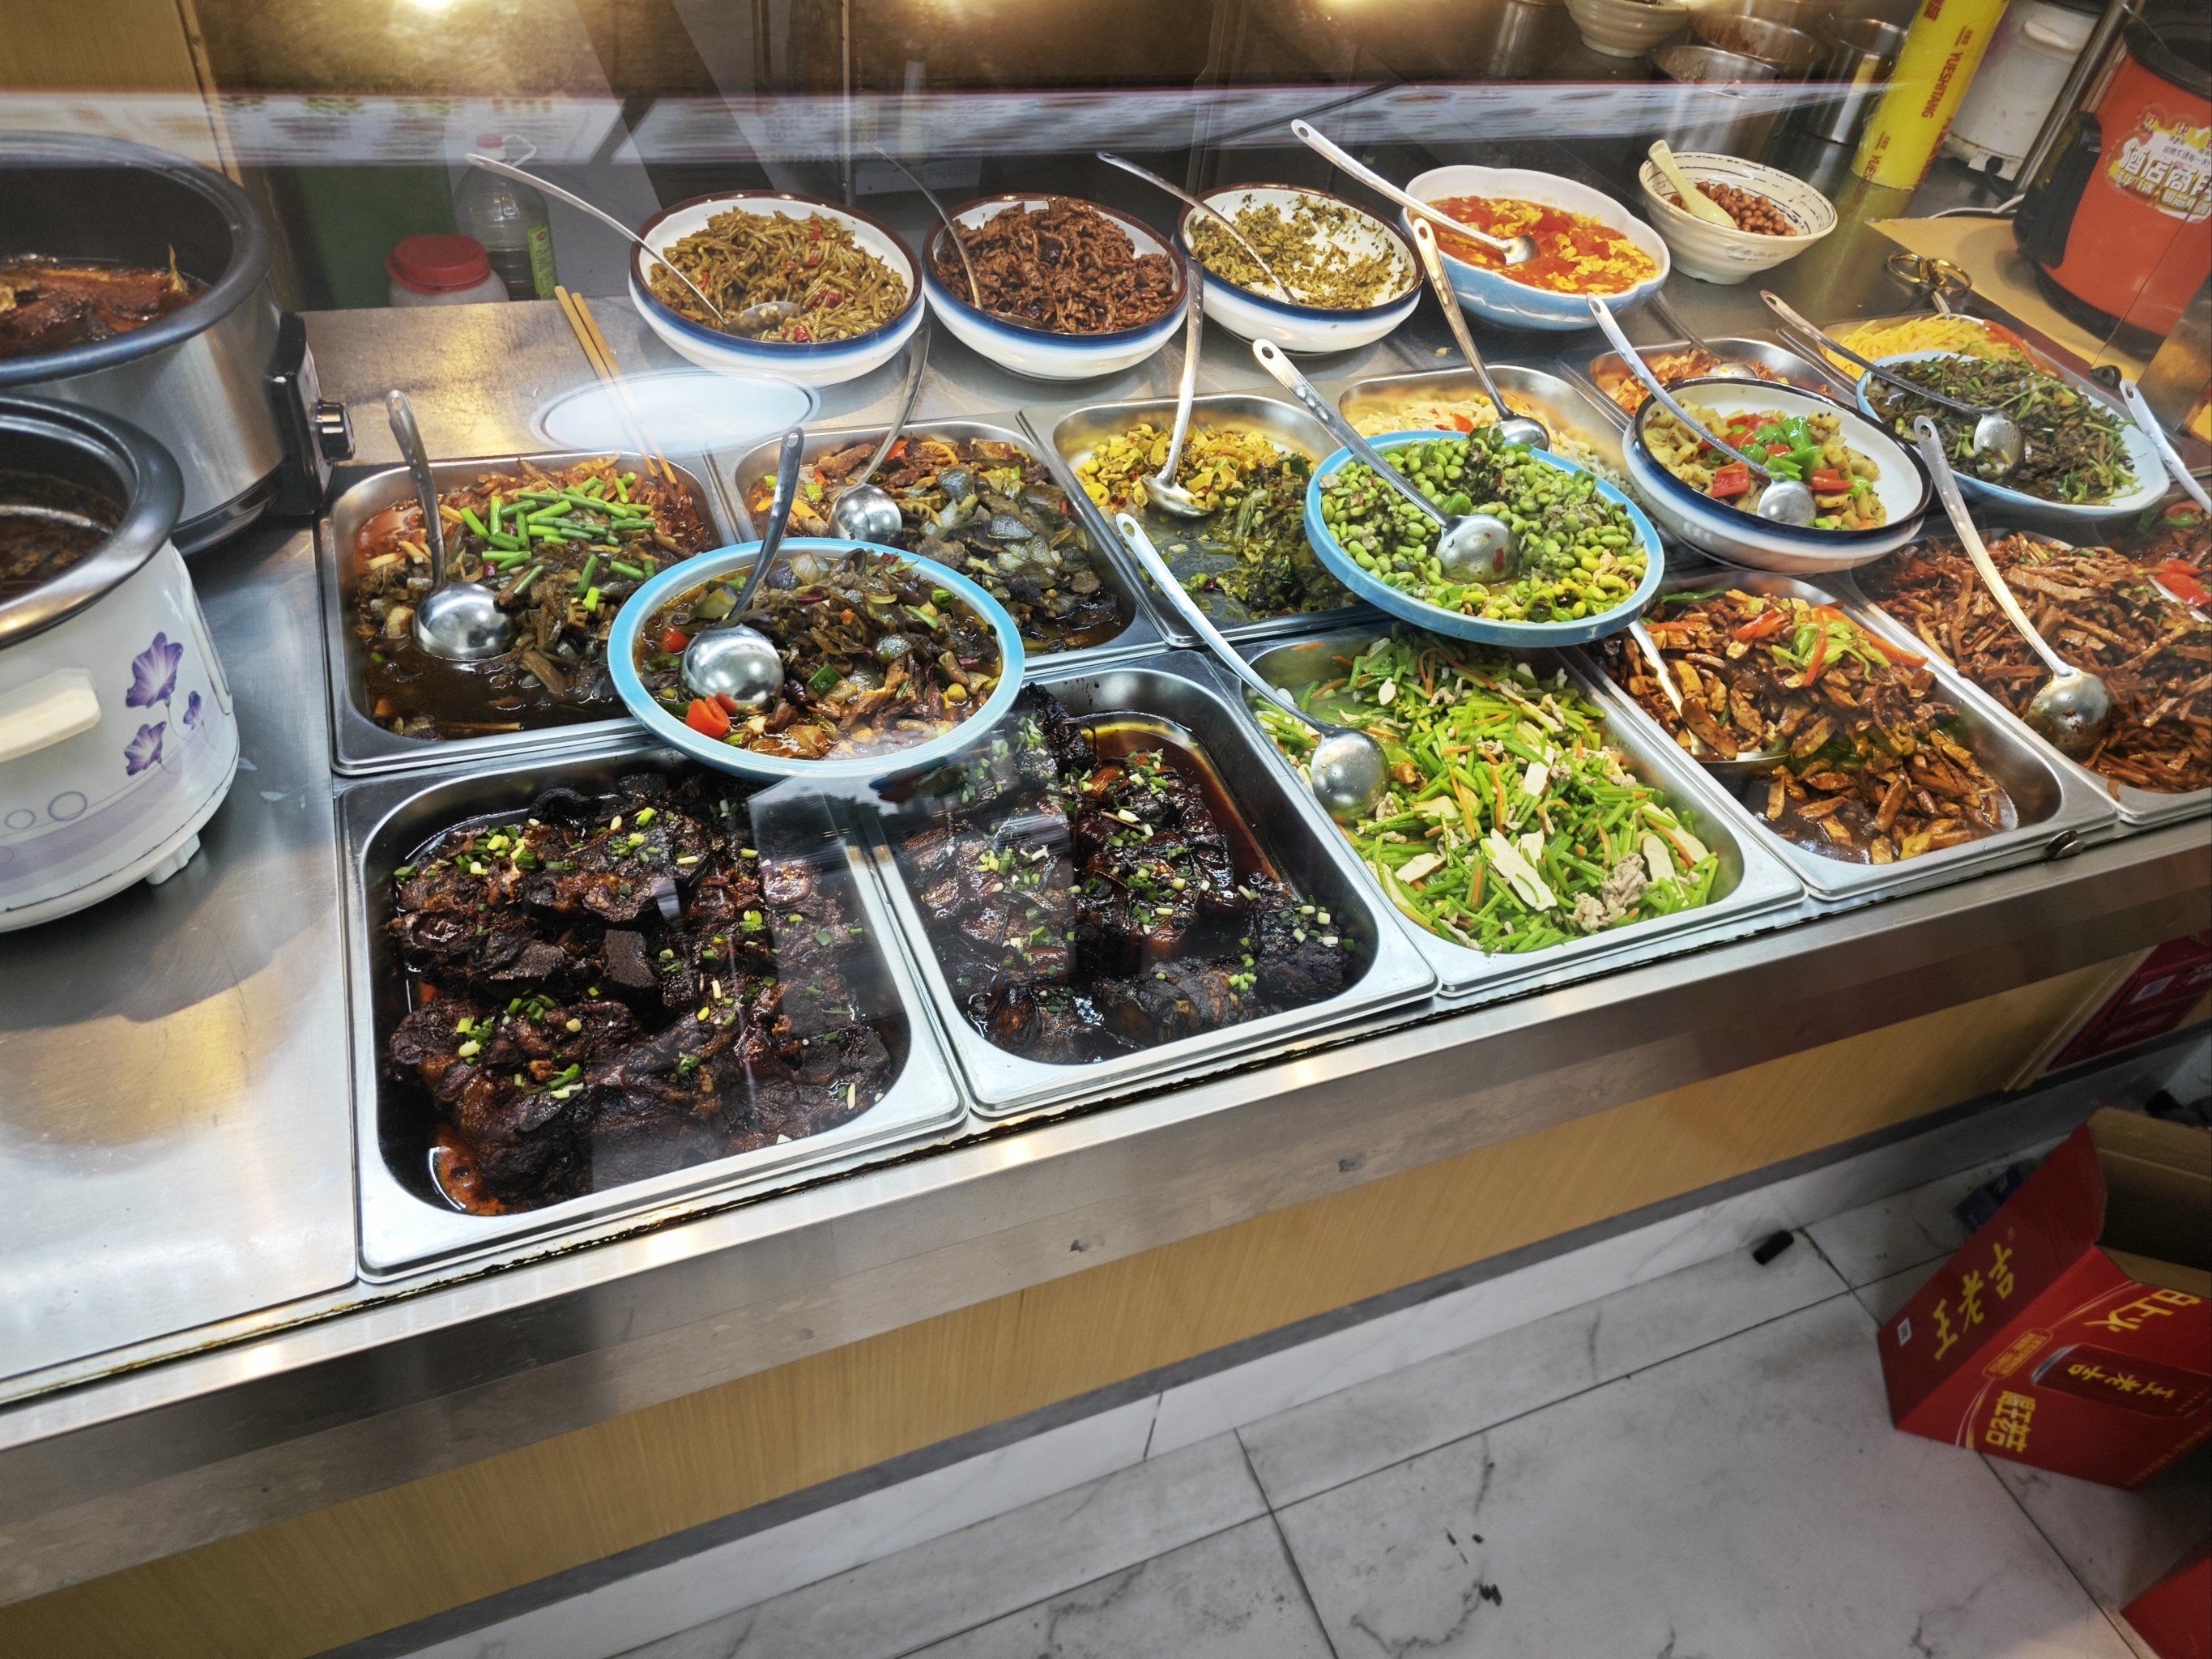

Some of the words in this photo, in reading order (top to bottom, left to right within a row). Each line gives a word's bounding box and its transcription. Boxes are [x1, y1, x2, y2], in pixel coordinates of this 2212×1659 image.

[1920, 51, 1964, 119] YUESHITANG
[1932, 1242, 2014, 1362] 王老吉
[2067, 1364, 2178, 1399] 王老吉
